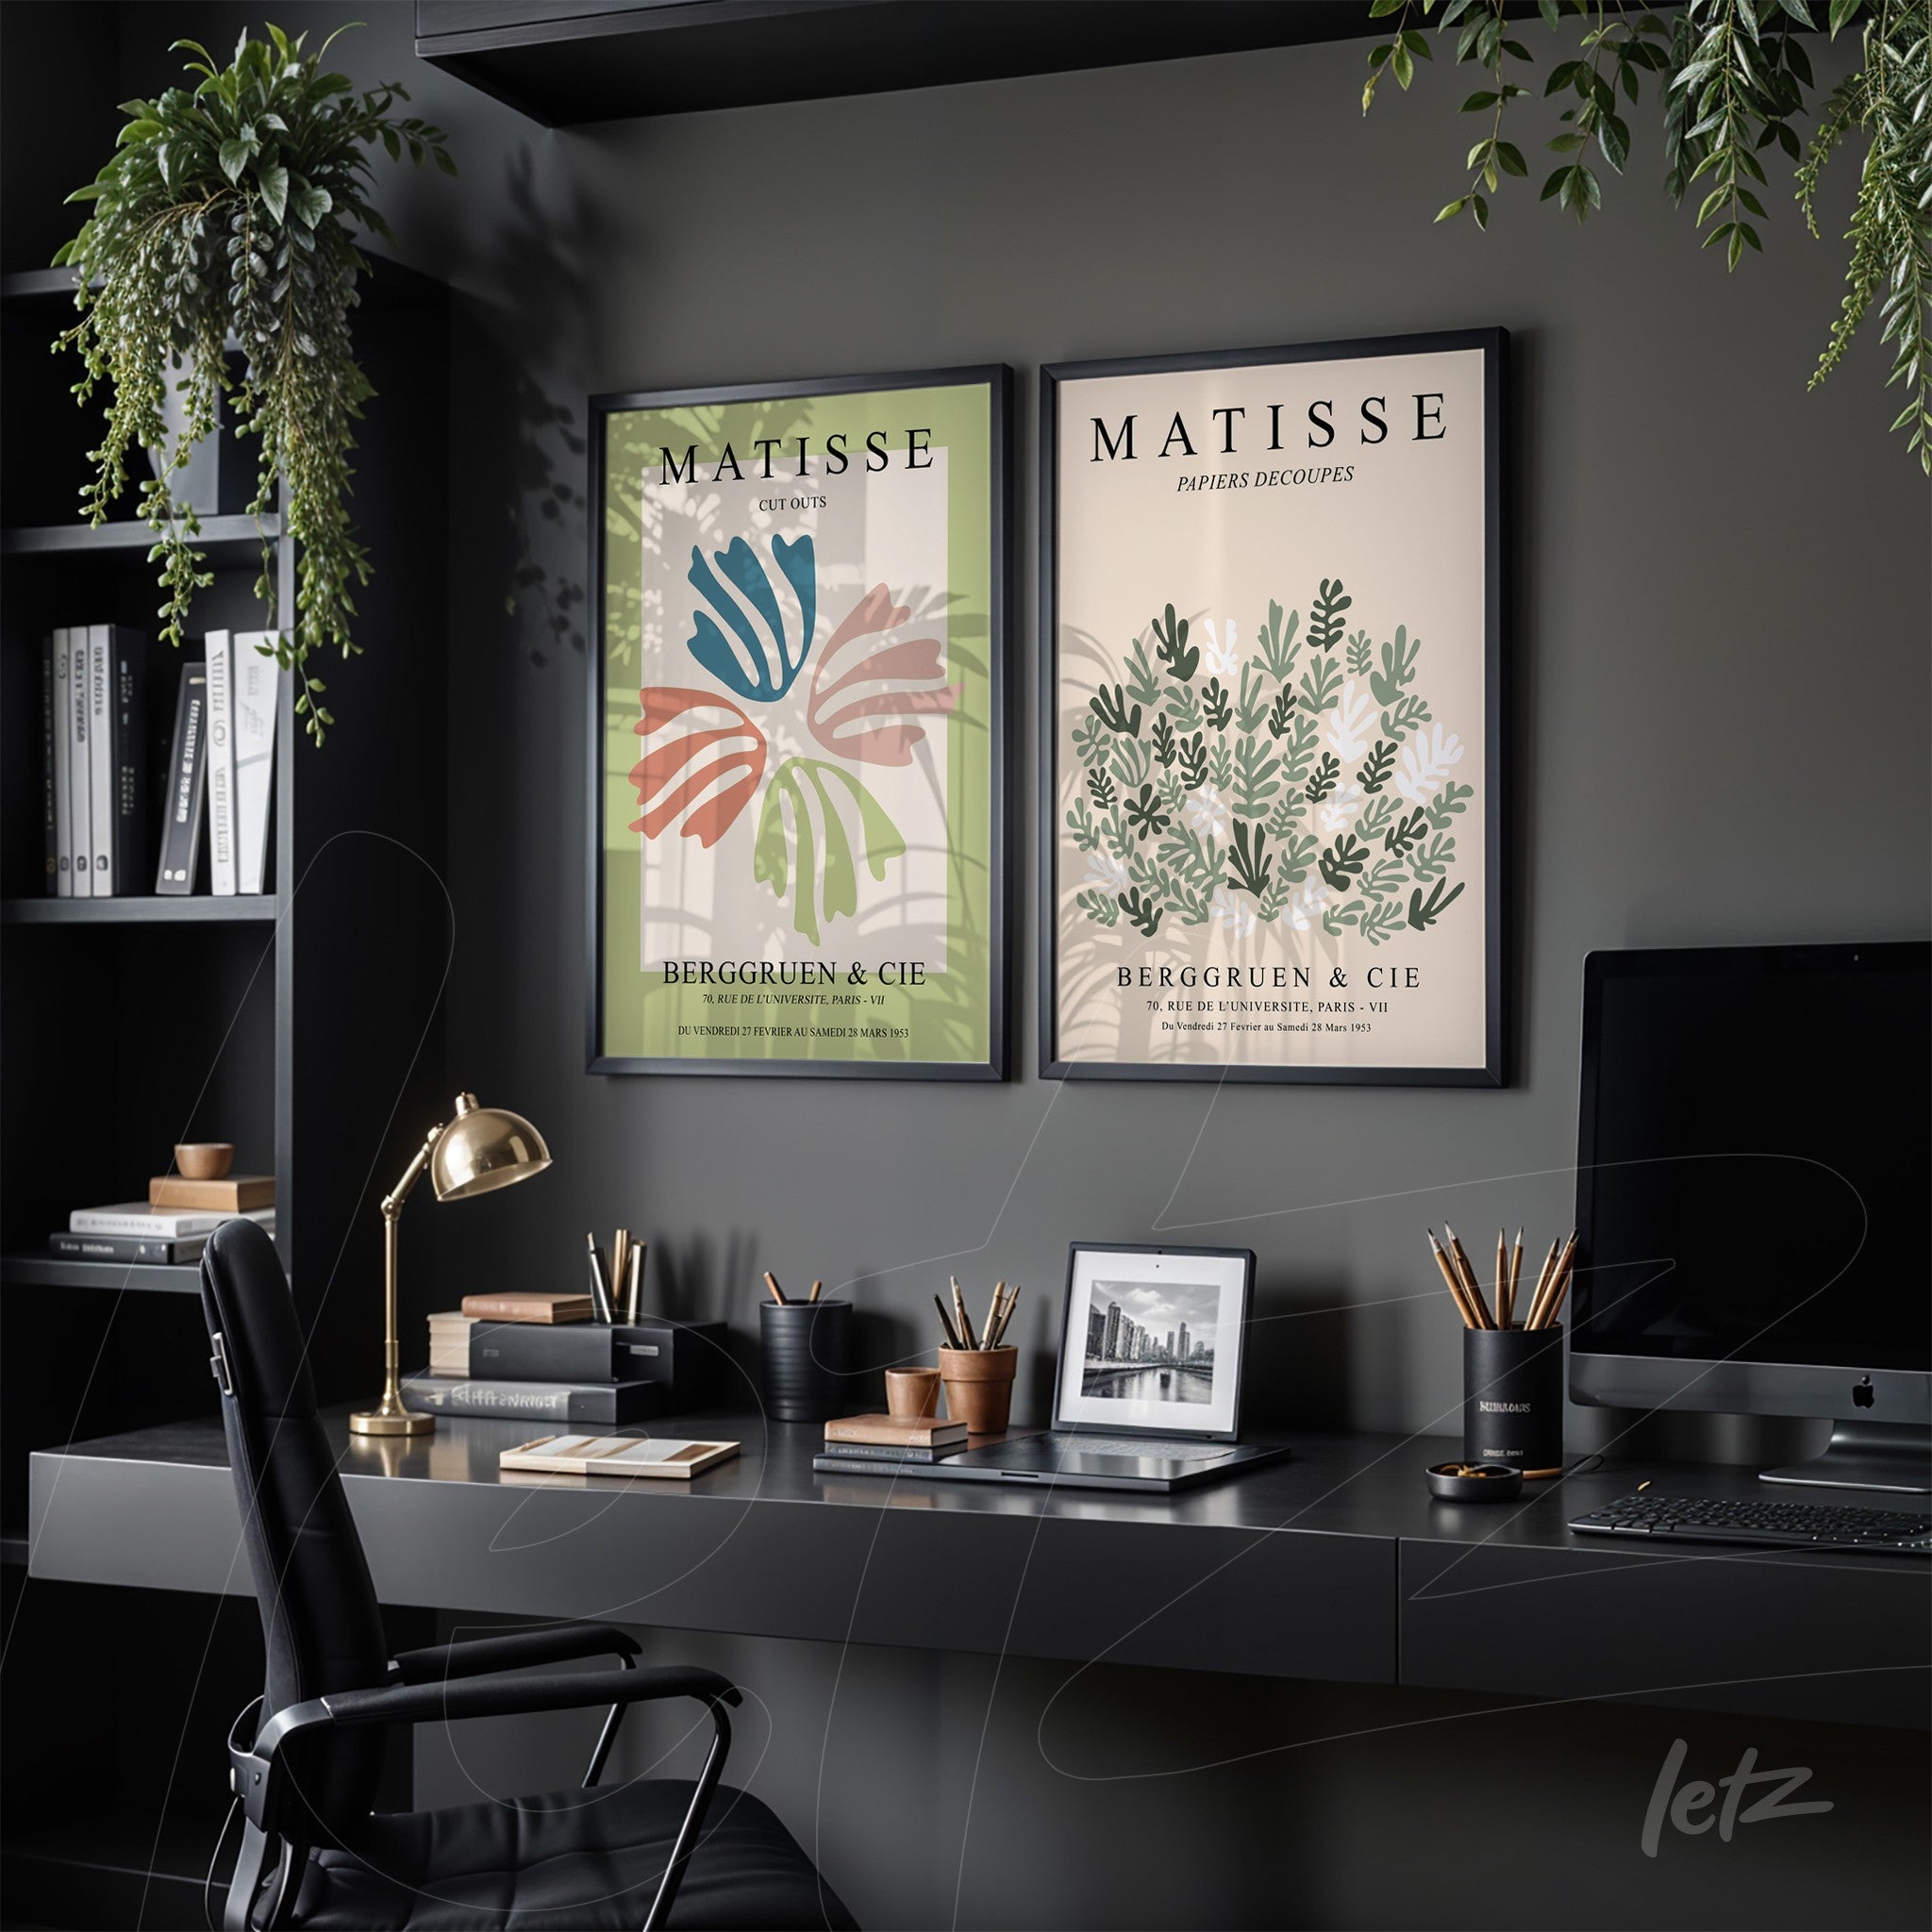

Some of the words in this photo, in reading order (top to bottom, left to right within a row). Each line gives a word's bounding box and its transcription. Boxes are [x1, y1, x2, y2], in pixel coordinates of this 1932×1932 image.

[1090, 392, 1447, 462] MATISSE
[658, 428, 935, 486] MATISSE
[1176, 472, 1250, 492] PAPIERS
[1254, 465, 1356, 488] DECOUPES
[758, 497, 788, 512] CUT
[790, 495, 827, 510] OUTS
[662, 960, 836, 986] BERGGRUEN
[847, 961, 868, 986] &
[878, 961, 926, 986] CIE
[1117, 966, 1311, 988] BERGGRUEN
[1328, 966, 1348, 989] &
[1367, 967, 1421, 989] CIE
[702, 993, 716, 1005] 70,
[717, 993, 739, 1005] RUE
[740, 994, 756, 1005] DE
[756, 994, 830, 1007] L'UNIVERSITE,
[831, 994, 861, 1006] PARIS
[870, 995, 886, 1006] VII
[1146, 1000, 1163, 1012] 70,
[1167, 1000, 1193, 1012] RUE
[1196, 1000, 1214, 1012] DE
[1218, 1001, 1314, 1013] L'UNIVERSITE,
[1317, 1001, 1356, 1013] PARIS
[1369, 1002, 1389, 1013] VII
[677, 1025, 692, 1037] DU
[692, 1025, 740, 1037] VENDREDI
[741, 1025, 752, 1037] 27
[753, 1026, 792, 1038] FEVRIER
[793, 1027, 808, 1038] AU
[809, 1027, 846, 1038] SAMEDI
[848, 1027, 858, 1038] 28
[860, 1027, 888, 1039] MARS
[890, 1027, 909, 1039] 1953
[1161, 1021, 1174, 1031] Du
[1175, 1021, 1214, 1031] Vendredi
[1216, 1021, 1227, 1031] 27
[1229, 1022, 1261, 1032] Fevrier
[1263, 1024, 1274, 1032] au
[1276, 1022, 1308, 1032] Samedi
[1310, 1022, 1323, 1032] 28
[1324, 1023, 1348, 1032] Mars
[1350, 1023, 1372, 1033] 1953
